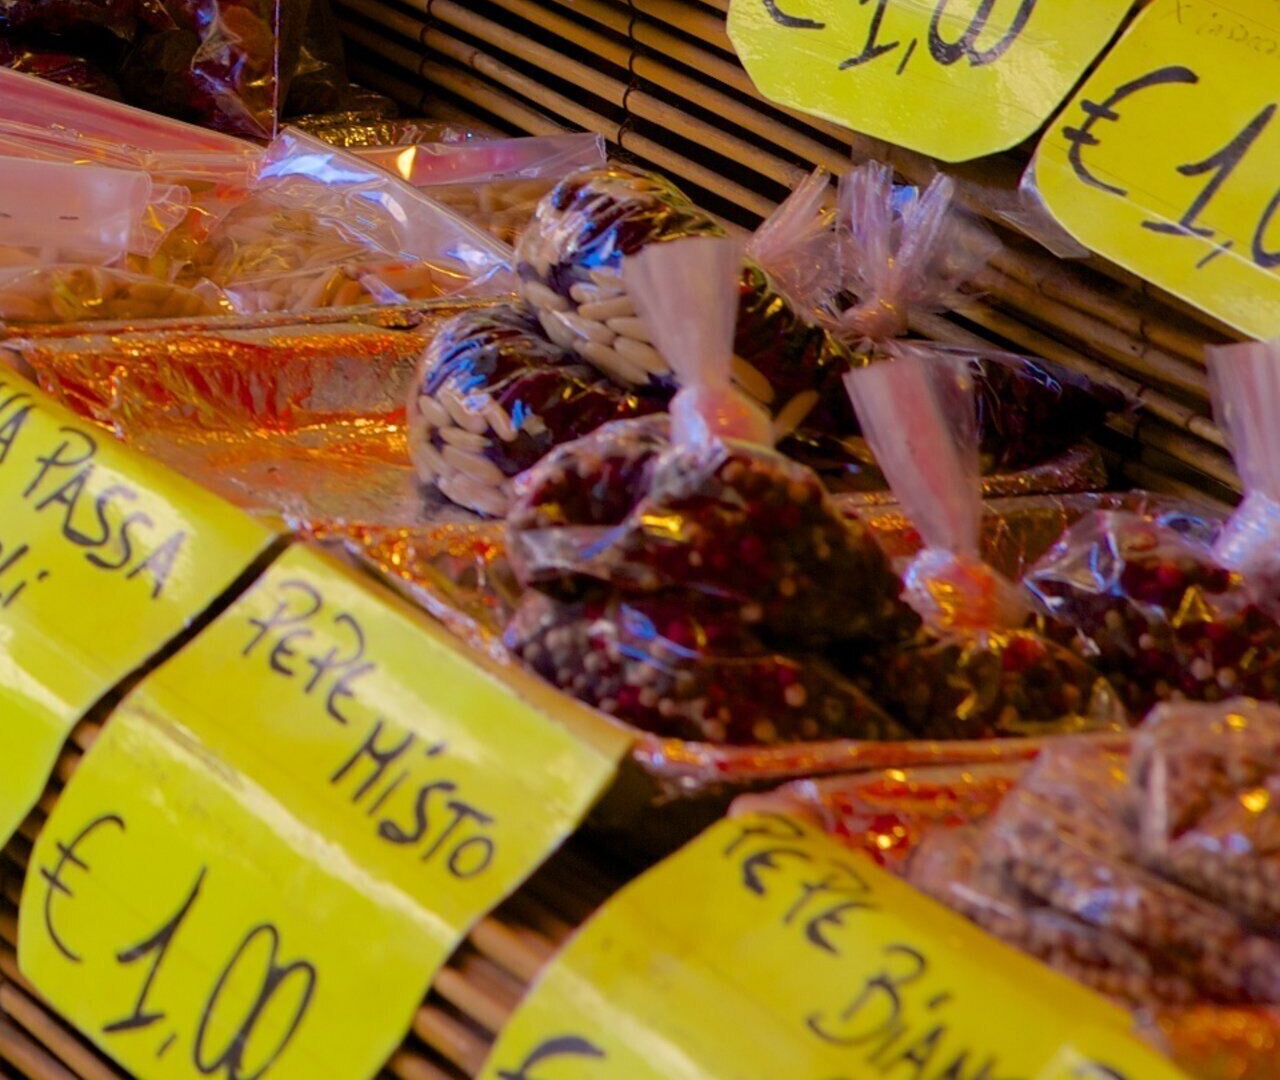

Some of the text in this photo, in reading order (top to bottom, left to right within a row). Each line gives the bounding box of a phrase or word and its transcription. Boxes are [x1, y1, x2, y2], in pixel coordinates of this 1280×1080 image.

[23, 427, 185, 600] PASSA
[243, 579, 376, 723] PEPE
[723, 812, 886, 955] PEPE
